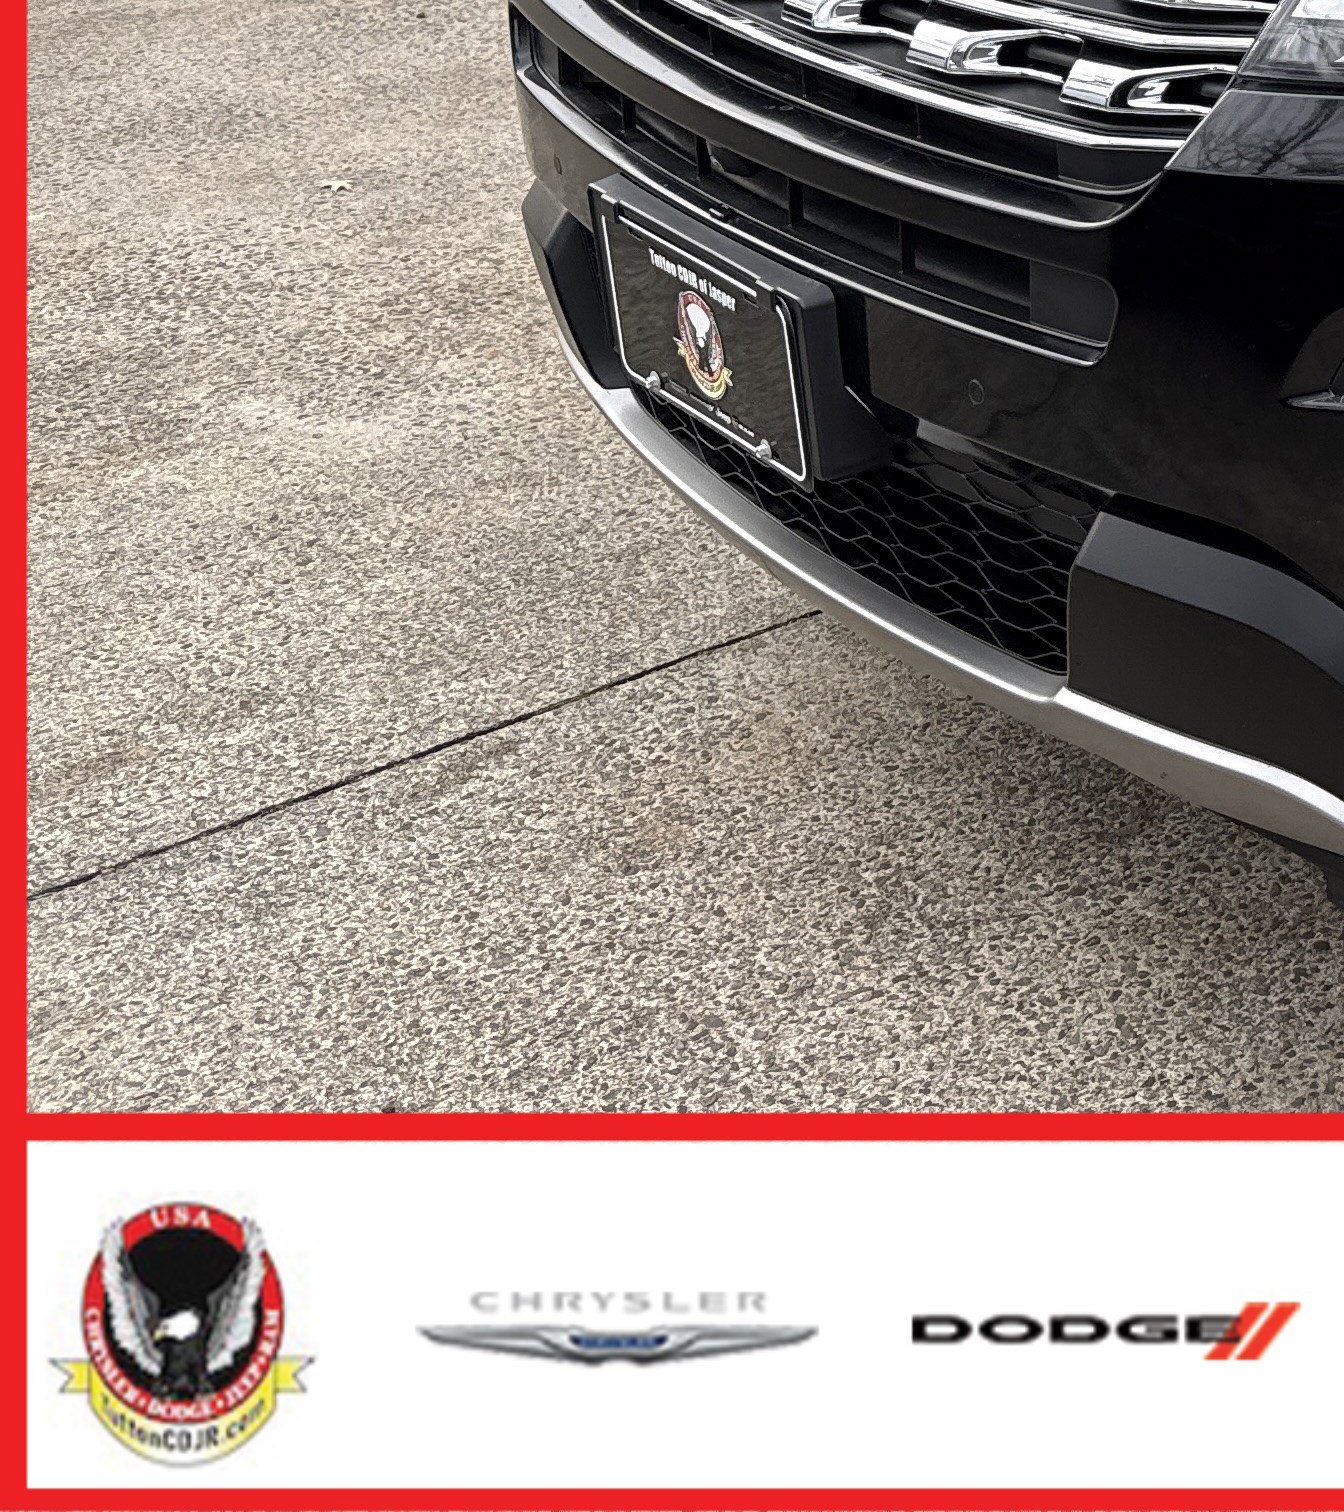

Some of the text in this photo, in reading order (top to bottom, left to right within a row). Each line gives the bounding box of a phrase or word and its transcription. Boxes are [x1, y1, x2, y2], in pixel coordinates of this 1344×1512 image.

[649, 248, 677, 277] Tutton
[677, 264, 698, 289] CDJR
[699, 279, 708, 295] of
[708, 282, 736, 311] Jasper
